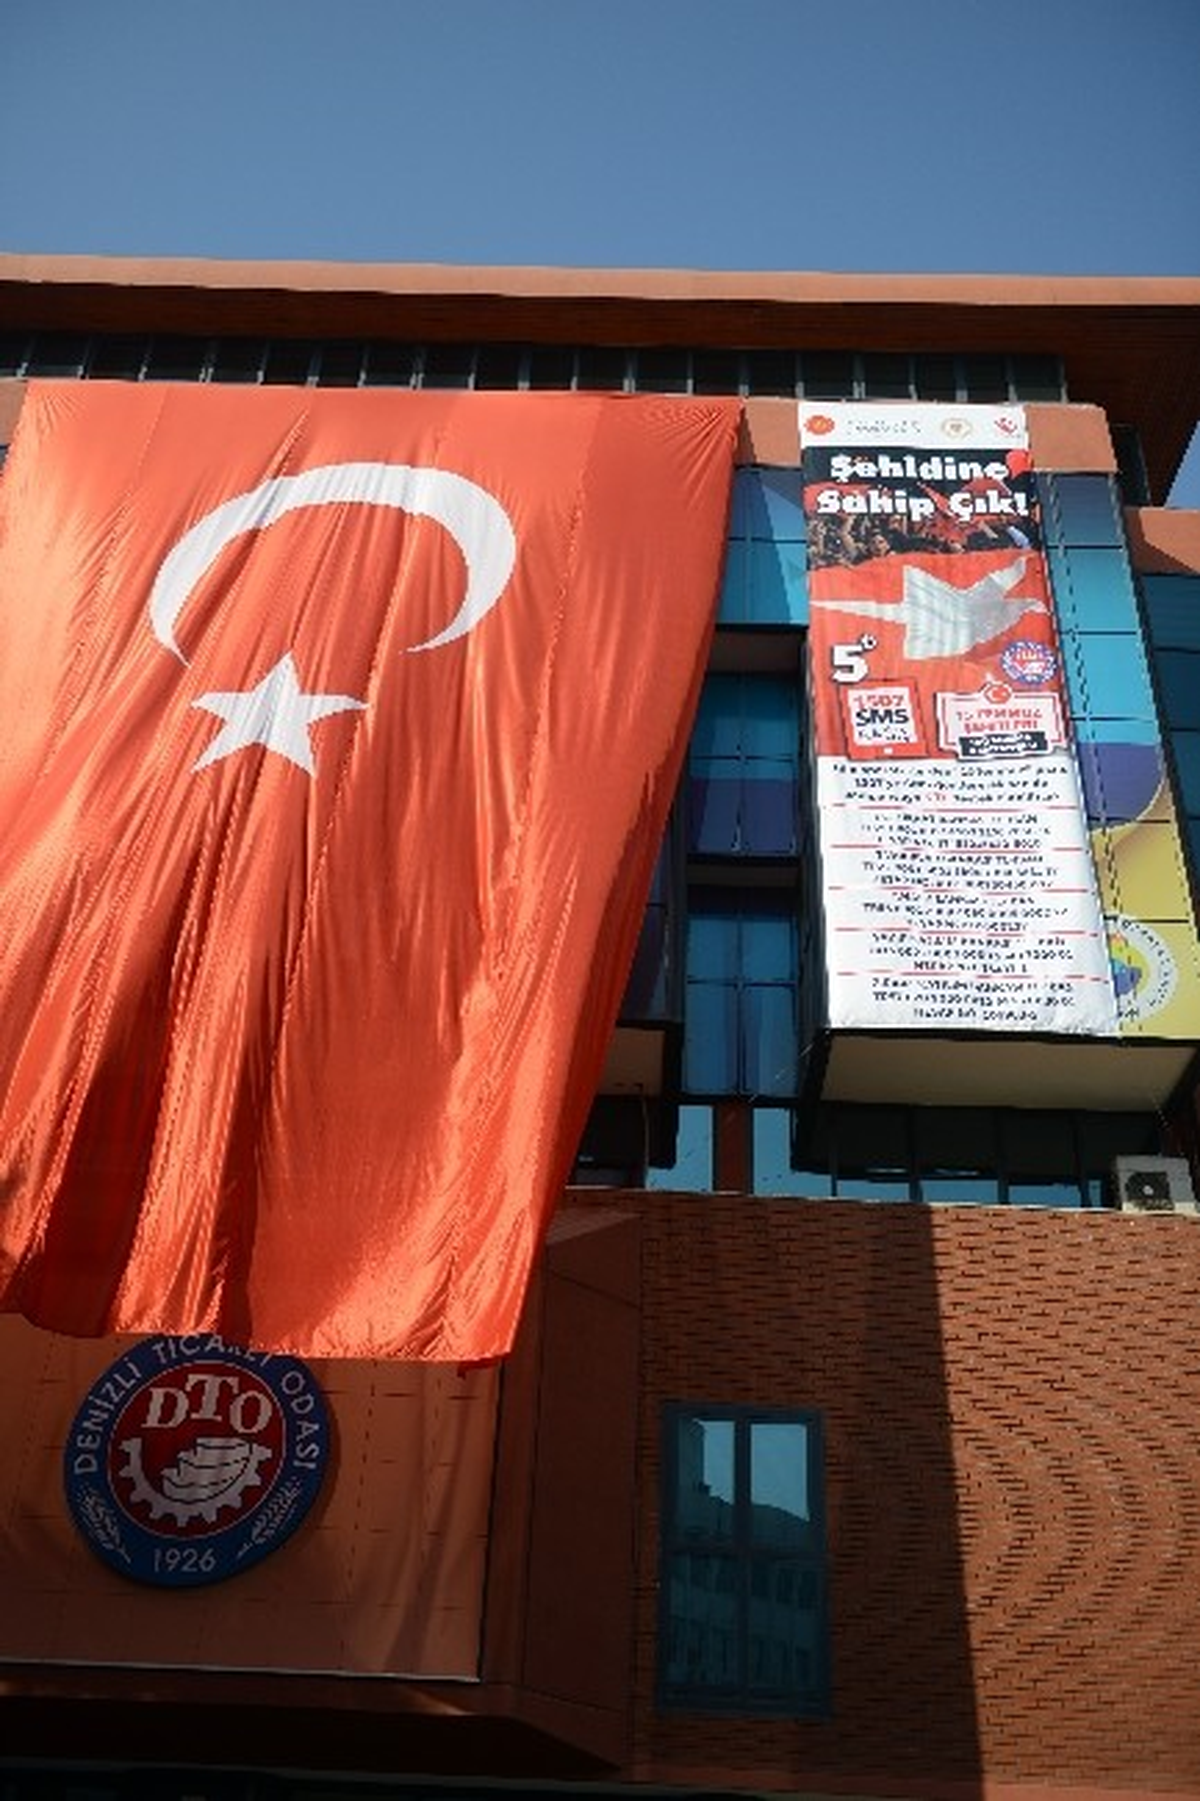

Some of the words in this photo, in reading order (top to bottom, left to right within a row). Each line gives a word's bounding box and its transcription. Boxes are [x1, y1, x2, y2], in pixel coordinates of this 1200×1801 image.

[817, 489, 935, 521] Sahip
[948, 490, 1028, 521] Çık!
[856, 709, 909, 726] SMS
[74, 1357, 142, 1474] DENİZLİ
[280, 1371, 320, 1470] ODASI
[141, 1373, 273, 1434] DTO
[153, 1548, 217, 1573] 1926
